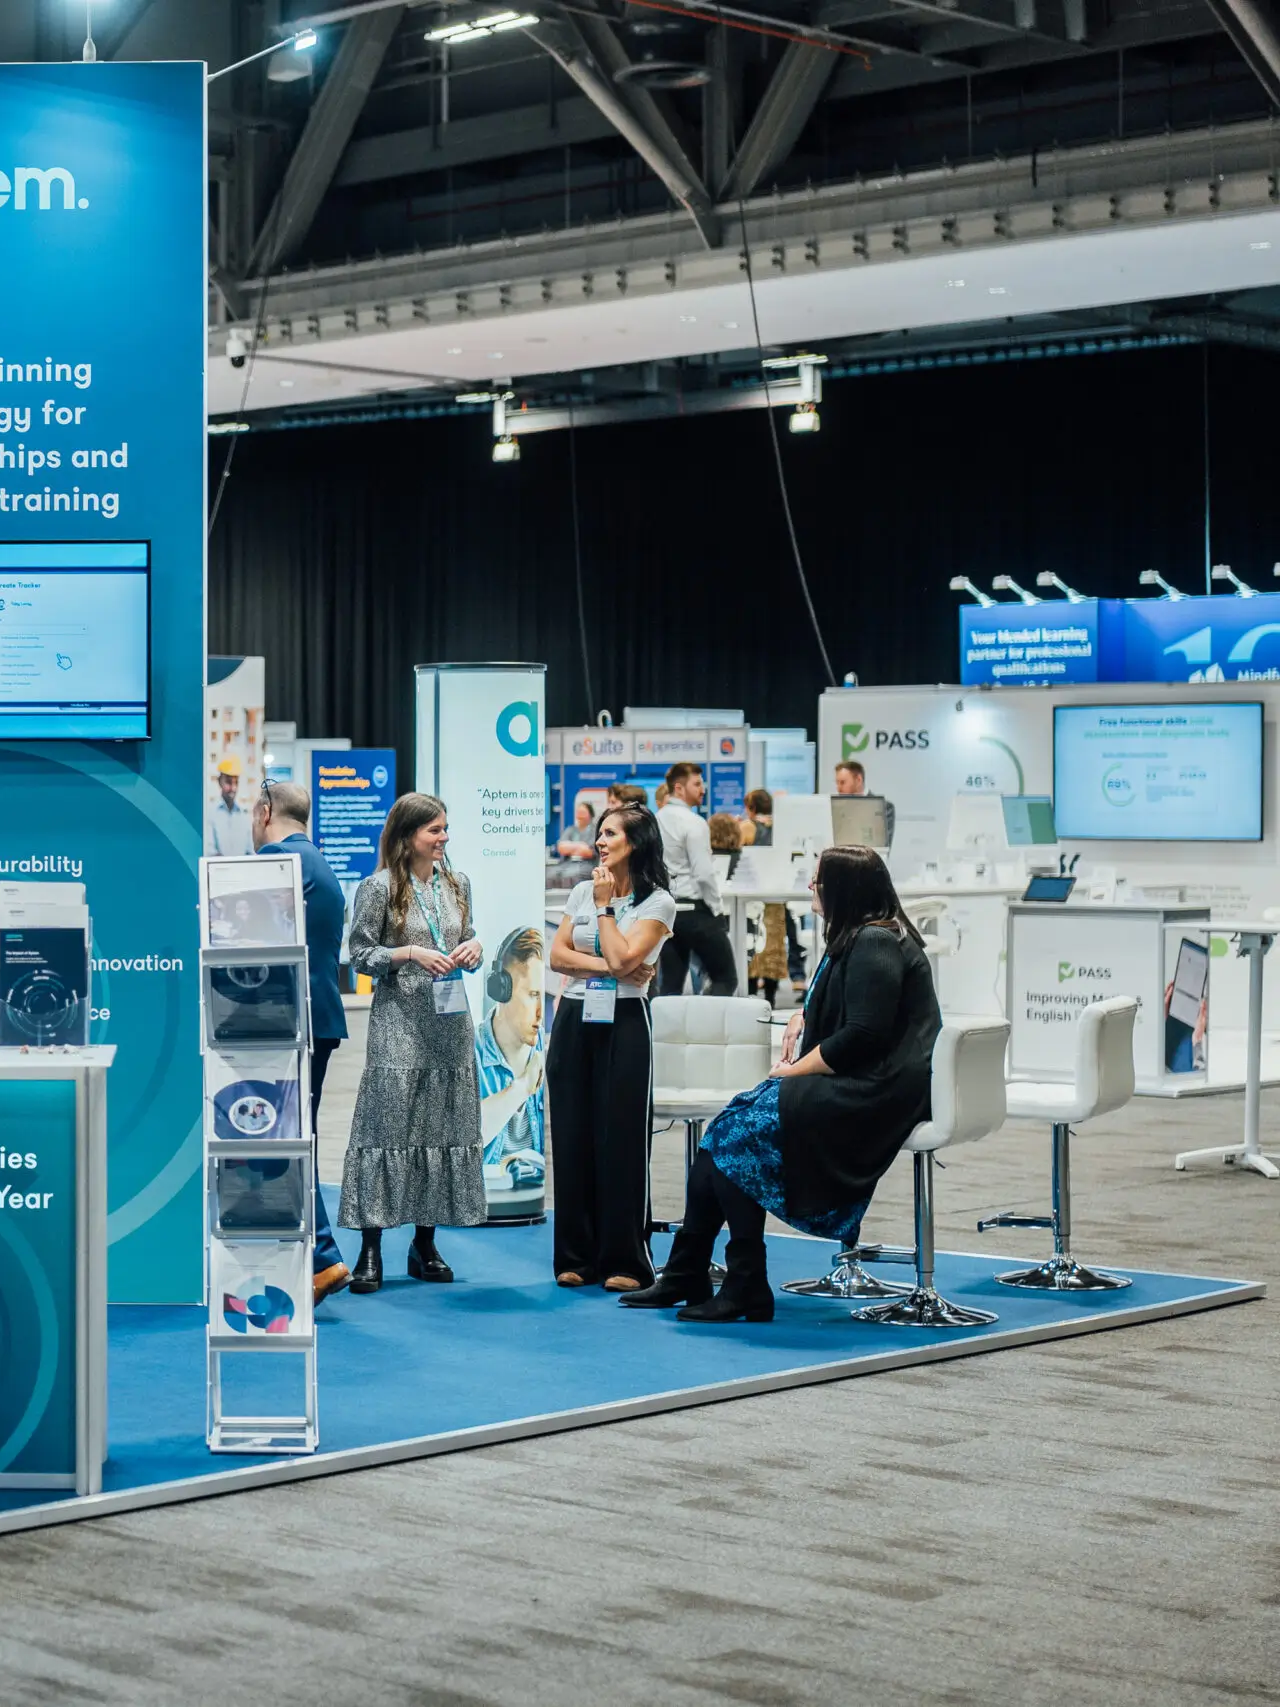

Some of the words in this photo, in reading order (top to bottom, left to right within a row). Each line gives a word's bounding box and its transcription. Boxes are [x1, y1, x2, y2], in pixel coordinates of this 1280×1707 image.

[42, 400, 87, 425] for
[71, 442, 129, 468] and
[997, 628, 1041, 644] blended
[1042, 627, 1088, 644] learning
[967, 648, 1008, 664] partner
[1008, 645, 1025, 660] for
[1026, 642, 1092, 661] professional
[992, 660, 1066, 678] qualifications
[572, 737, 623, 756] eSuite
[875, 730, 930, 749] PASS
[520, 788, 527, 798] is
[482, 806, 501, 819] key
[504, 806, 534, 816] drivers
[482, 848, 517, 857] Corndel
[89, 954, 184, 971] nnovation
[1078, 966, 1112, 979] PASS
[1026, 990, 1089, 1006] Improving
[1026, 1008, 1072, 1024] English
